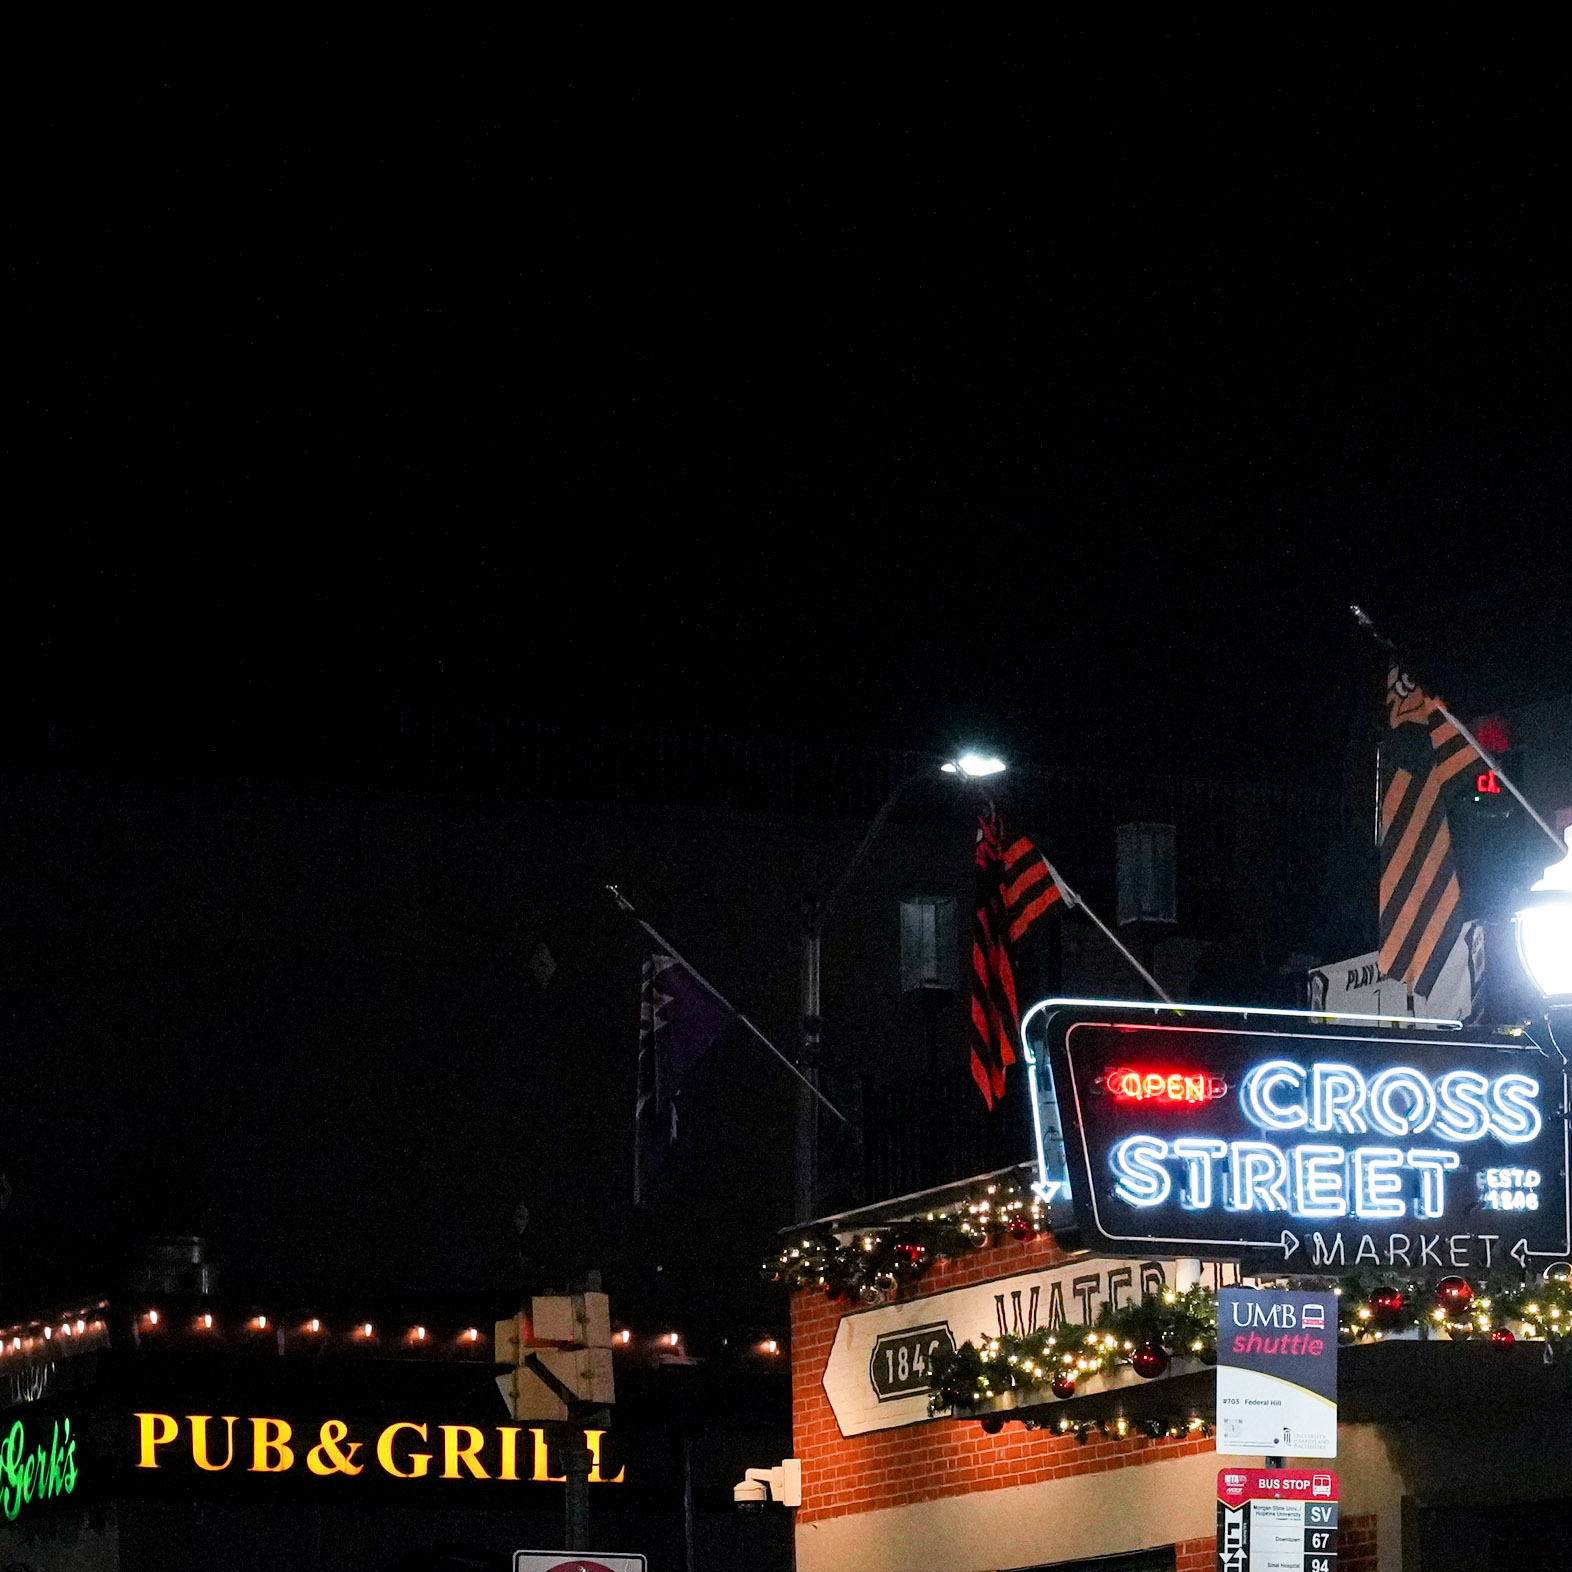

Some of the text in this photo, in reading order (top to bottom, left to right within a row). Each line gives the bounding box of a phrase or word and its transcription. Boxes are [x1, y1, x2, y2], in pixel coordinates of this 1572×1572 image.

[1346, 964, 1374, 991] PLAY
[1122, 1072, 1204, 1101] OPEN
[1240, 1060, 1542, 1144] CROSS
[1110, 1135, 1461, 1220] STREET
[1313, 1231, 1500, 1269] MARKET
[1232, 1302, 1297, 1328] UMB
[1232, 1331, 1325, 1356] shuttle
[1244, 1398, 1270, 1406] Federal
[134, 1412, 627, 1486] PUB&GRILL
[0, 1417, 79, 1521] Gerk's
[1258, 1478, 1311, 1490] BUS STOP
[1310, 1506, 1332, 1522] SV
[1312, 1533, 1329, 1548] 67
